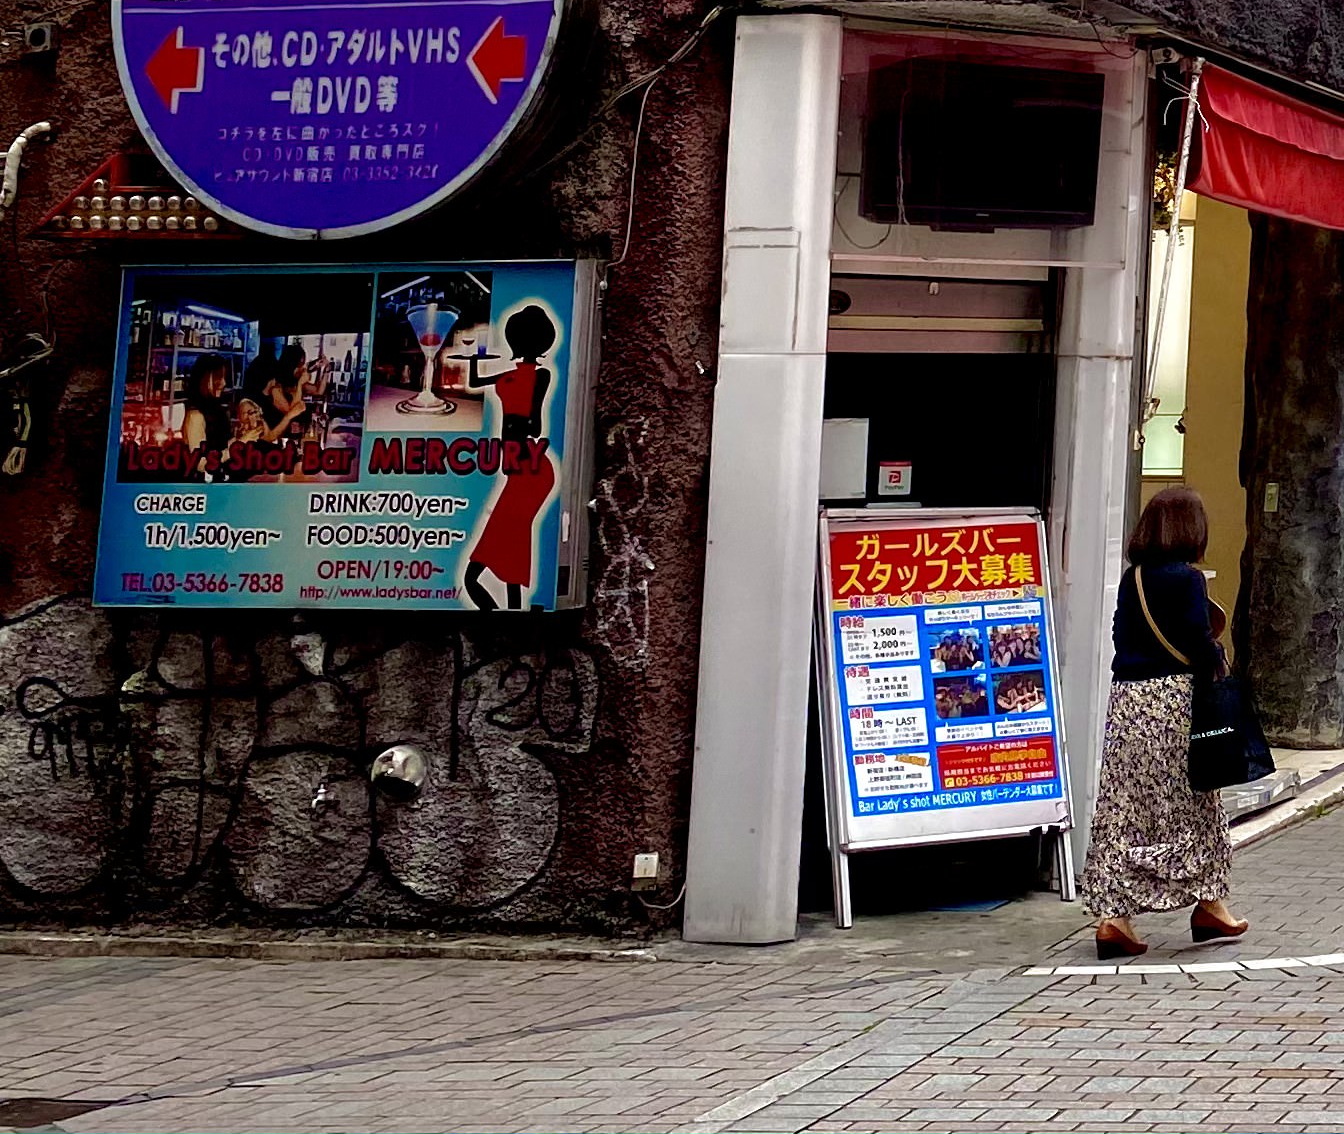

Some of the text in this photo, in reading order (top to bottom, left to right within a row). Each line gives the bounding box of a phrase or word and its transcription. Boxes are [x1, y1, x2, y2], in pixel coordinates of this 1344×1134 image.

[230, 439, 298, 476] Shot
[301, 441, 356, 477] Bar
[368, 437, 551, 477] MERCURY
[135, 494, 206, 514] CHARGE
[855, 528, 1021, 561] ガールズバー
[838, 553, 1036, 595] スタッフ大募集
[299, 584, 463, 602] http://www.ladysbar.net/
[871, 627, 897, 638] 1,500
[872, 639, 899, 651] 2,000
[895, 716, 918, 727] LAST
[955, 771, 1024, 787] 03-5366-7838
[858, 800, 875, 813] Bar
[910, 796, 931, 809] shot
[932, 790, 978, 806] MERCURY
